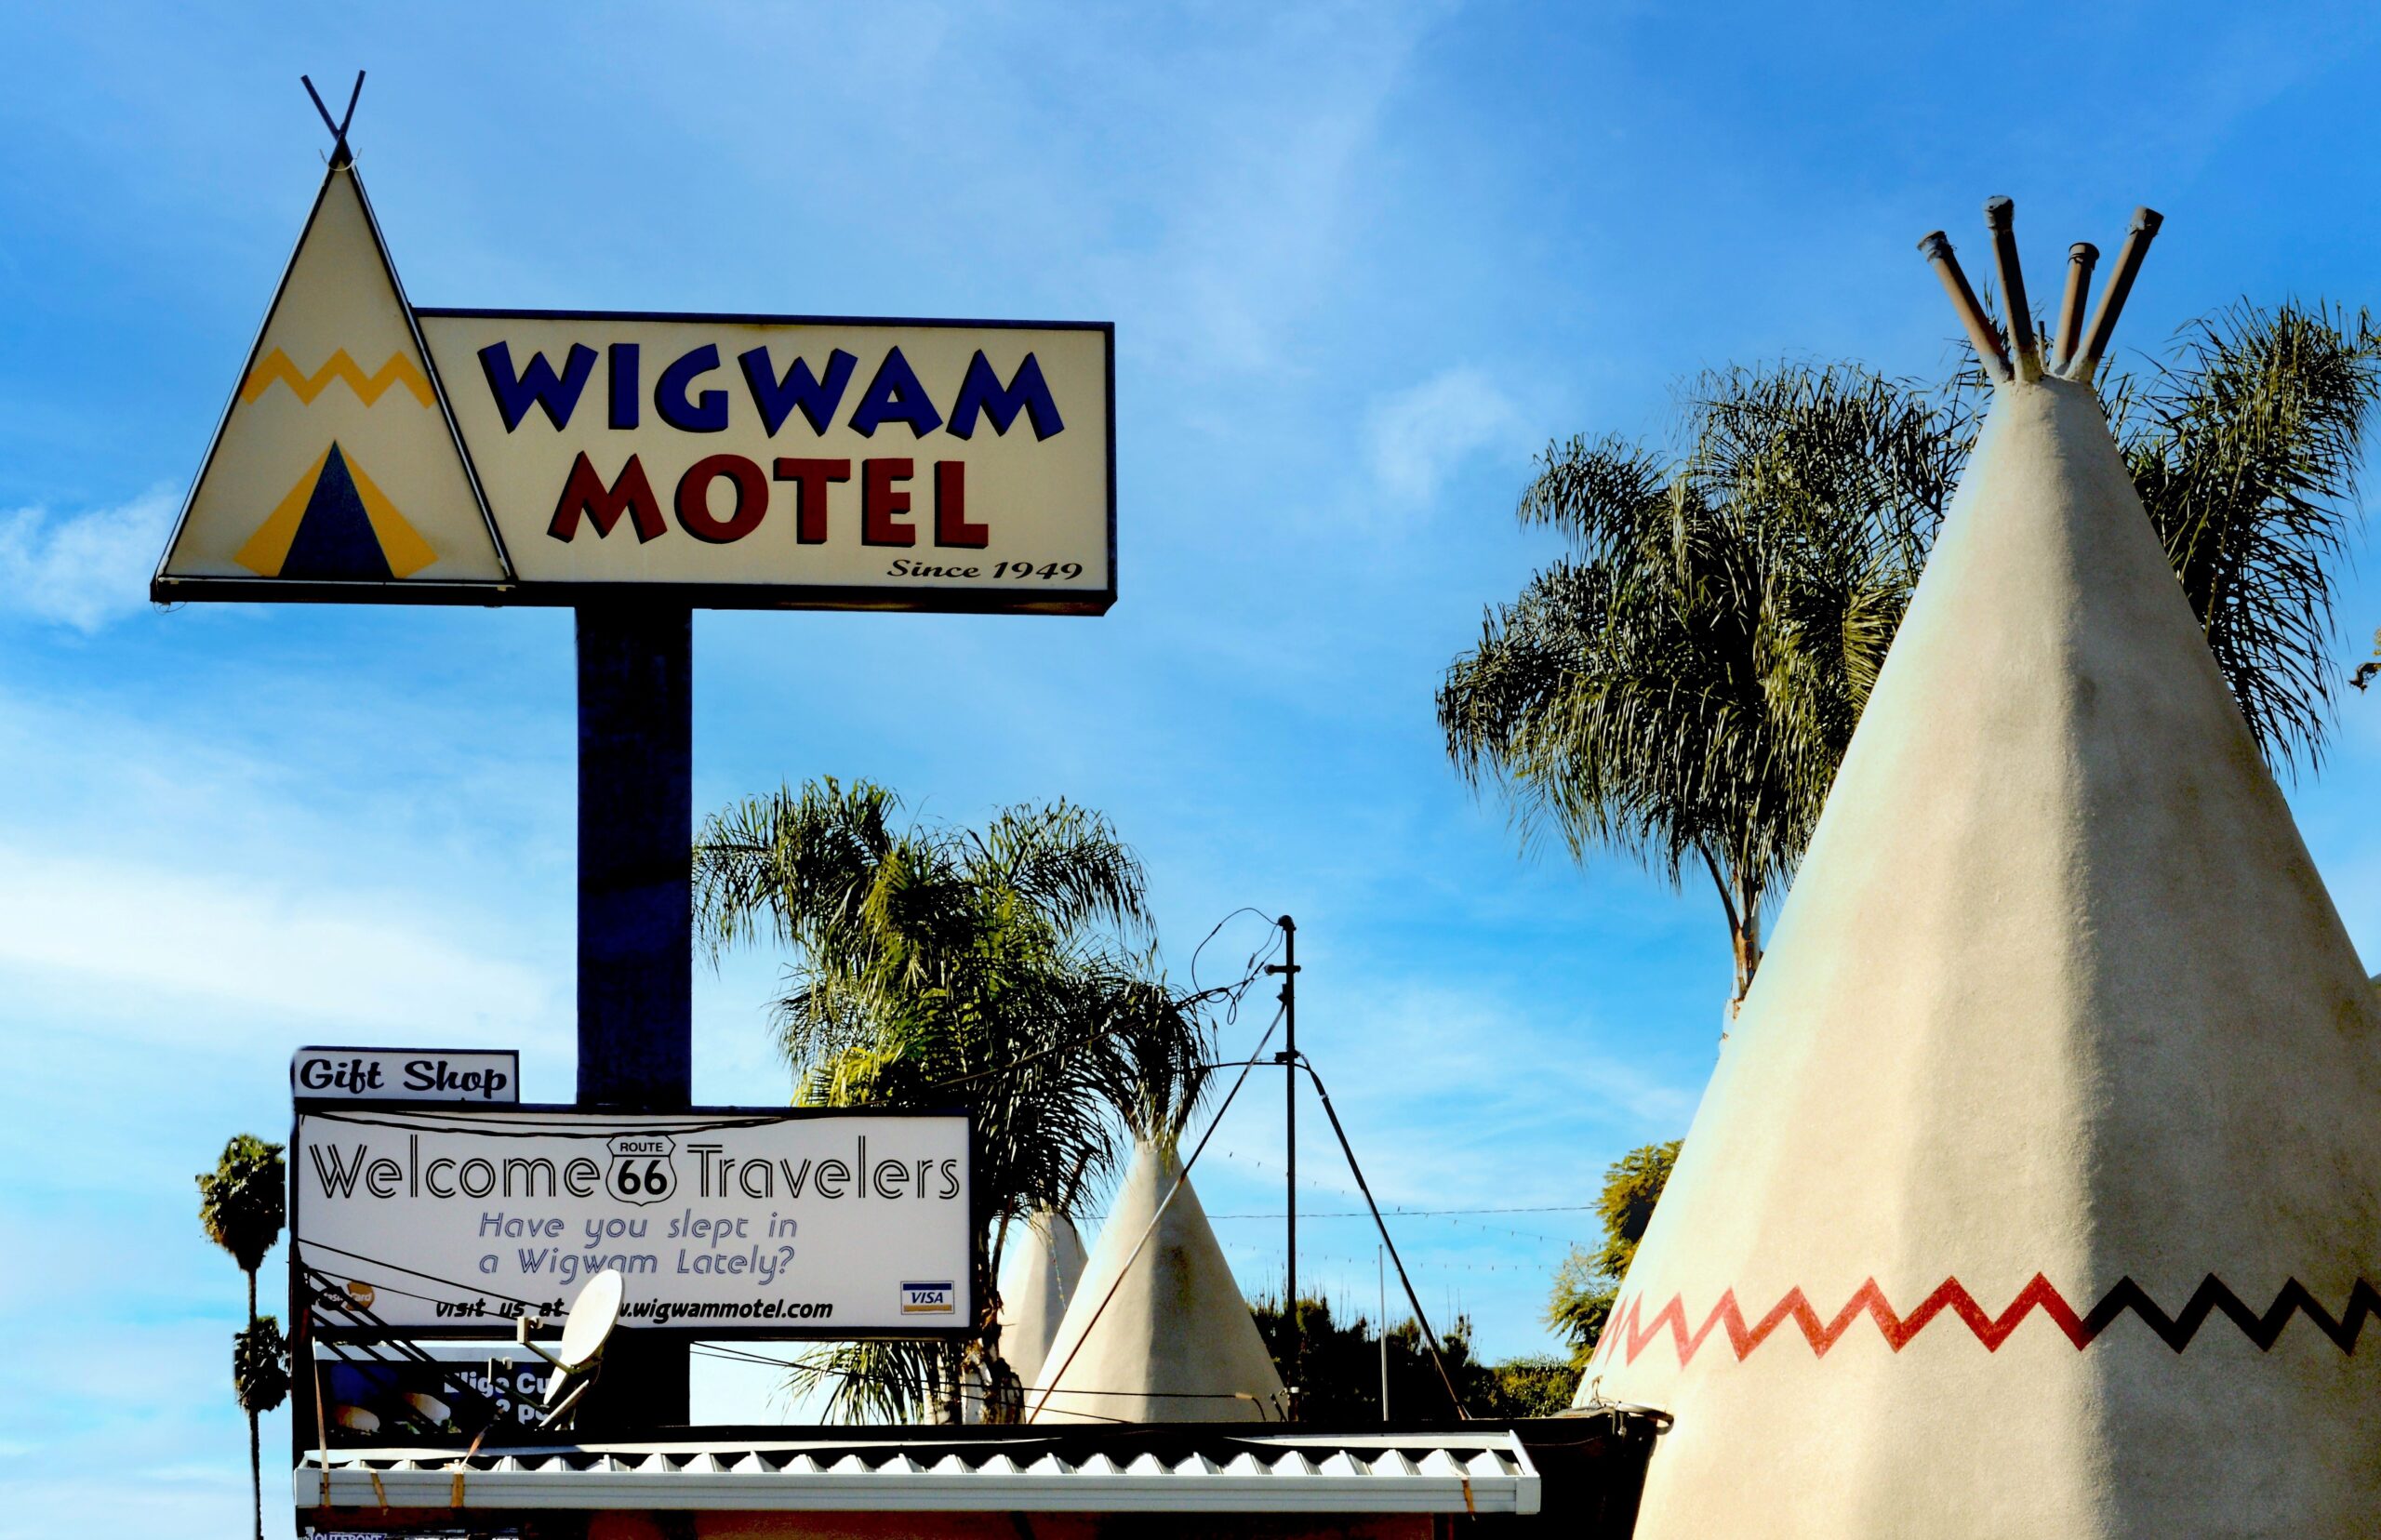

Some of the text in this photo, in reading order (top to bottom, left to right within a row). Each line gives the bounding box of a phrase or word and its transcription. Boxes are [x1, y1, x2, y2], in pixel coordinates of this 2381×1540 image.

[476, 340, 1065, 442] WIGWAM
[546, 450, 990, 550] MOTEL
[886, 559, 1084, 580] Since 1949
[299, 1058, 508, 1099] Gift Shop
[309, 1134, 960, 1200] Welcome Travelers
[619, 1141, 664, 1153] ROUTE
[617, 1159, 668, 1196] 66
[478, 1209, 798, 1250] Have you slept in
[478, 1244, 795, 1286] a Wigwam Lately?
[435, 1297, 833, 1324] visit us at .wigwammotel.com
[911, 1292, 944, 1305] VISA
